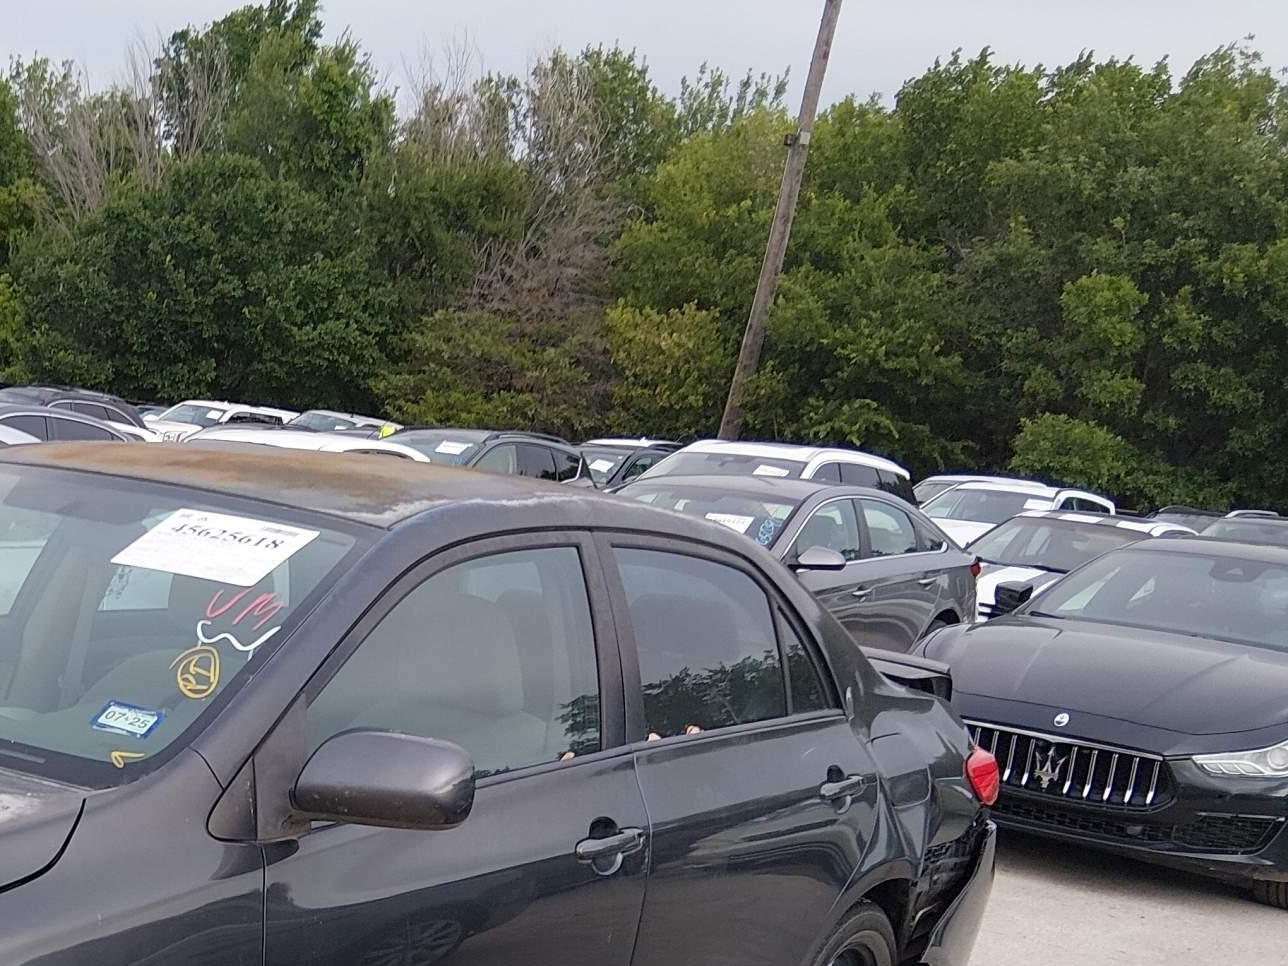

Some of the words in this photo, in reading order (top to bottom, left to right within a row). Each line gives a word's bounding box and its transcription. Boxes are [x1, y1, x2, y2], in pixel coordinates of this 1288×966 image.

[172, 523, 283, 549] 45625618
[105, 710, 127, 721] 07
[128, 717, 150, 729] 25
